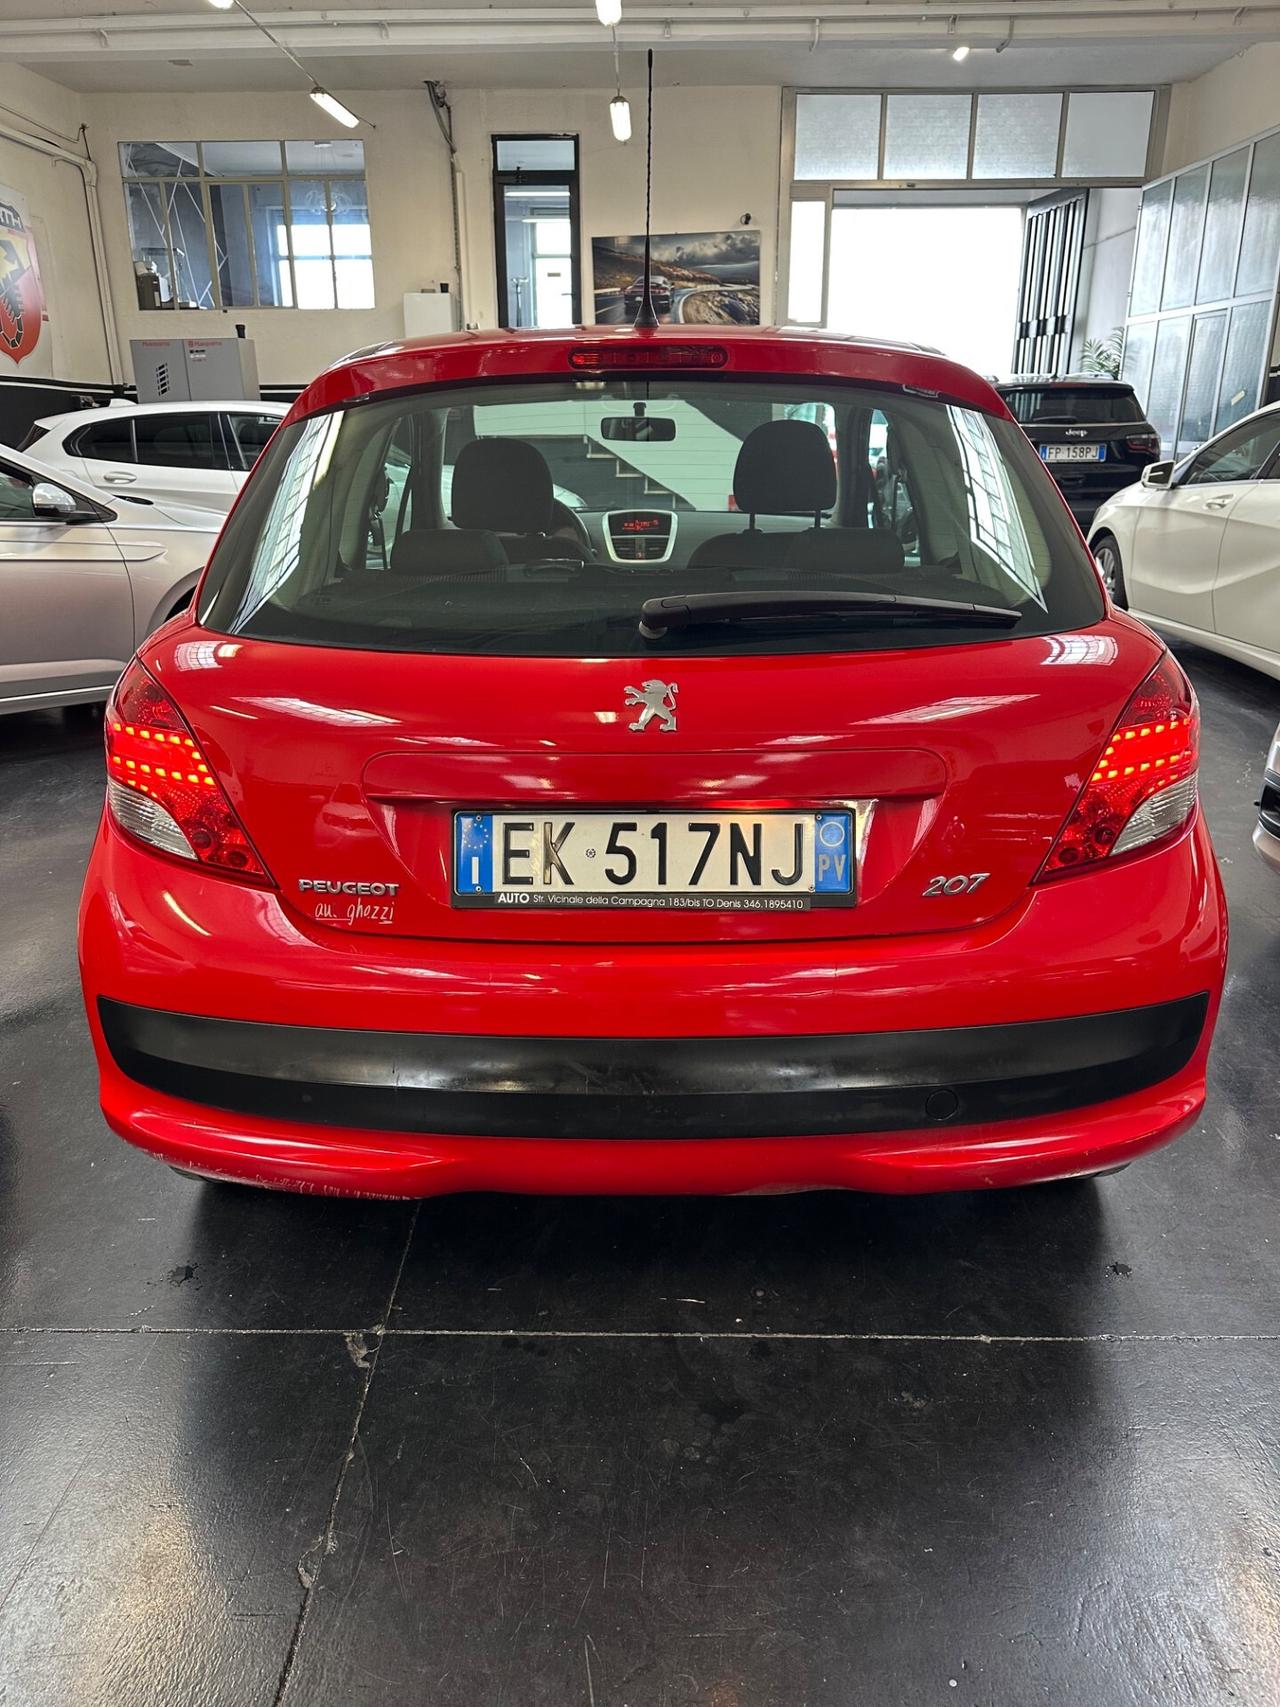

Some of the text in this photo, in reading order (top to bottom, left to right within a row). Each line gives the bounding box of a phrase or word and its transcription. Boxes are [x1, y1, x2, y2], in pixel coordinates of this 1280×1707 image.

[1065, 429, 1088, 437] Jeep
[1048, 446, 1098, 459] FP 158PJ
[502, 821, 575, 886] EK
[604, 821, 804, 886] 517NJ
[818, 854, 846, 881] PV
[298, 879, 400, 897] PEUGEOT
[922, 872, 991, 897] 207
[498, 893, 804, 910] AUTO Str. Vicinale della Campagna 183/bis TO Denis 346.1895410
